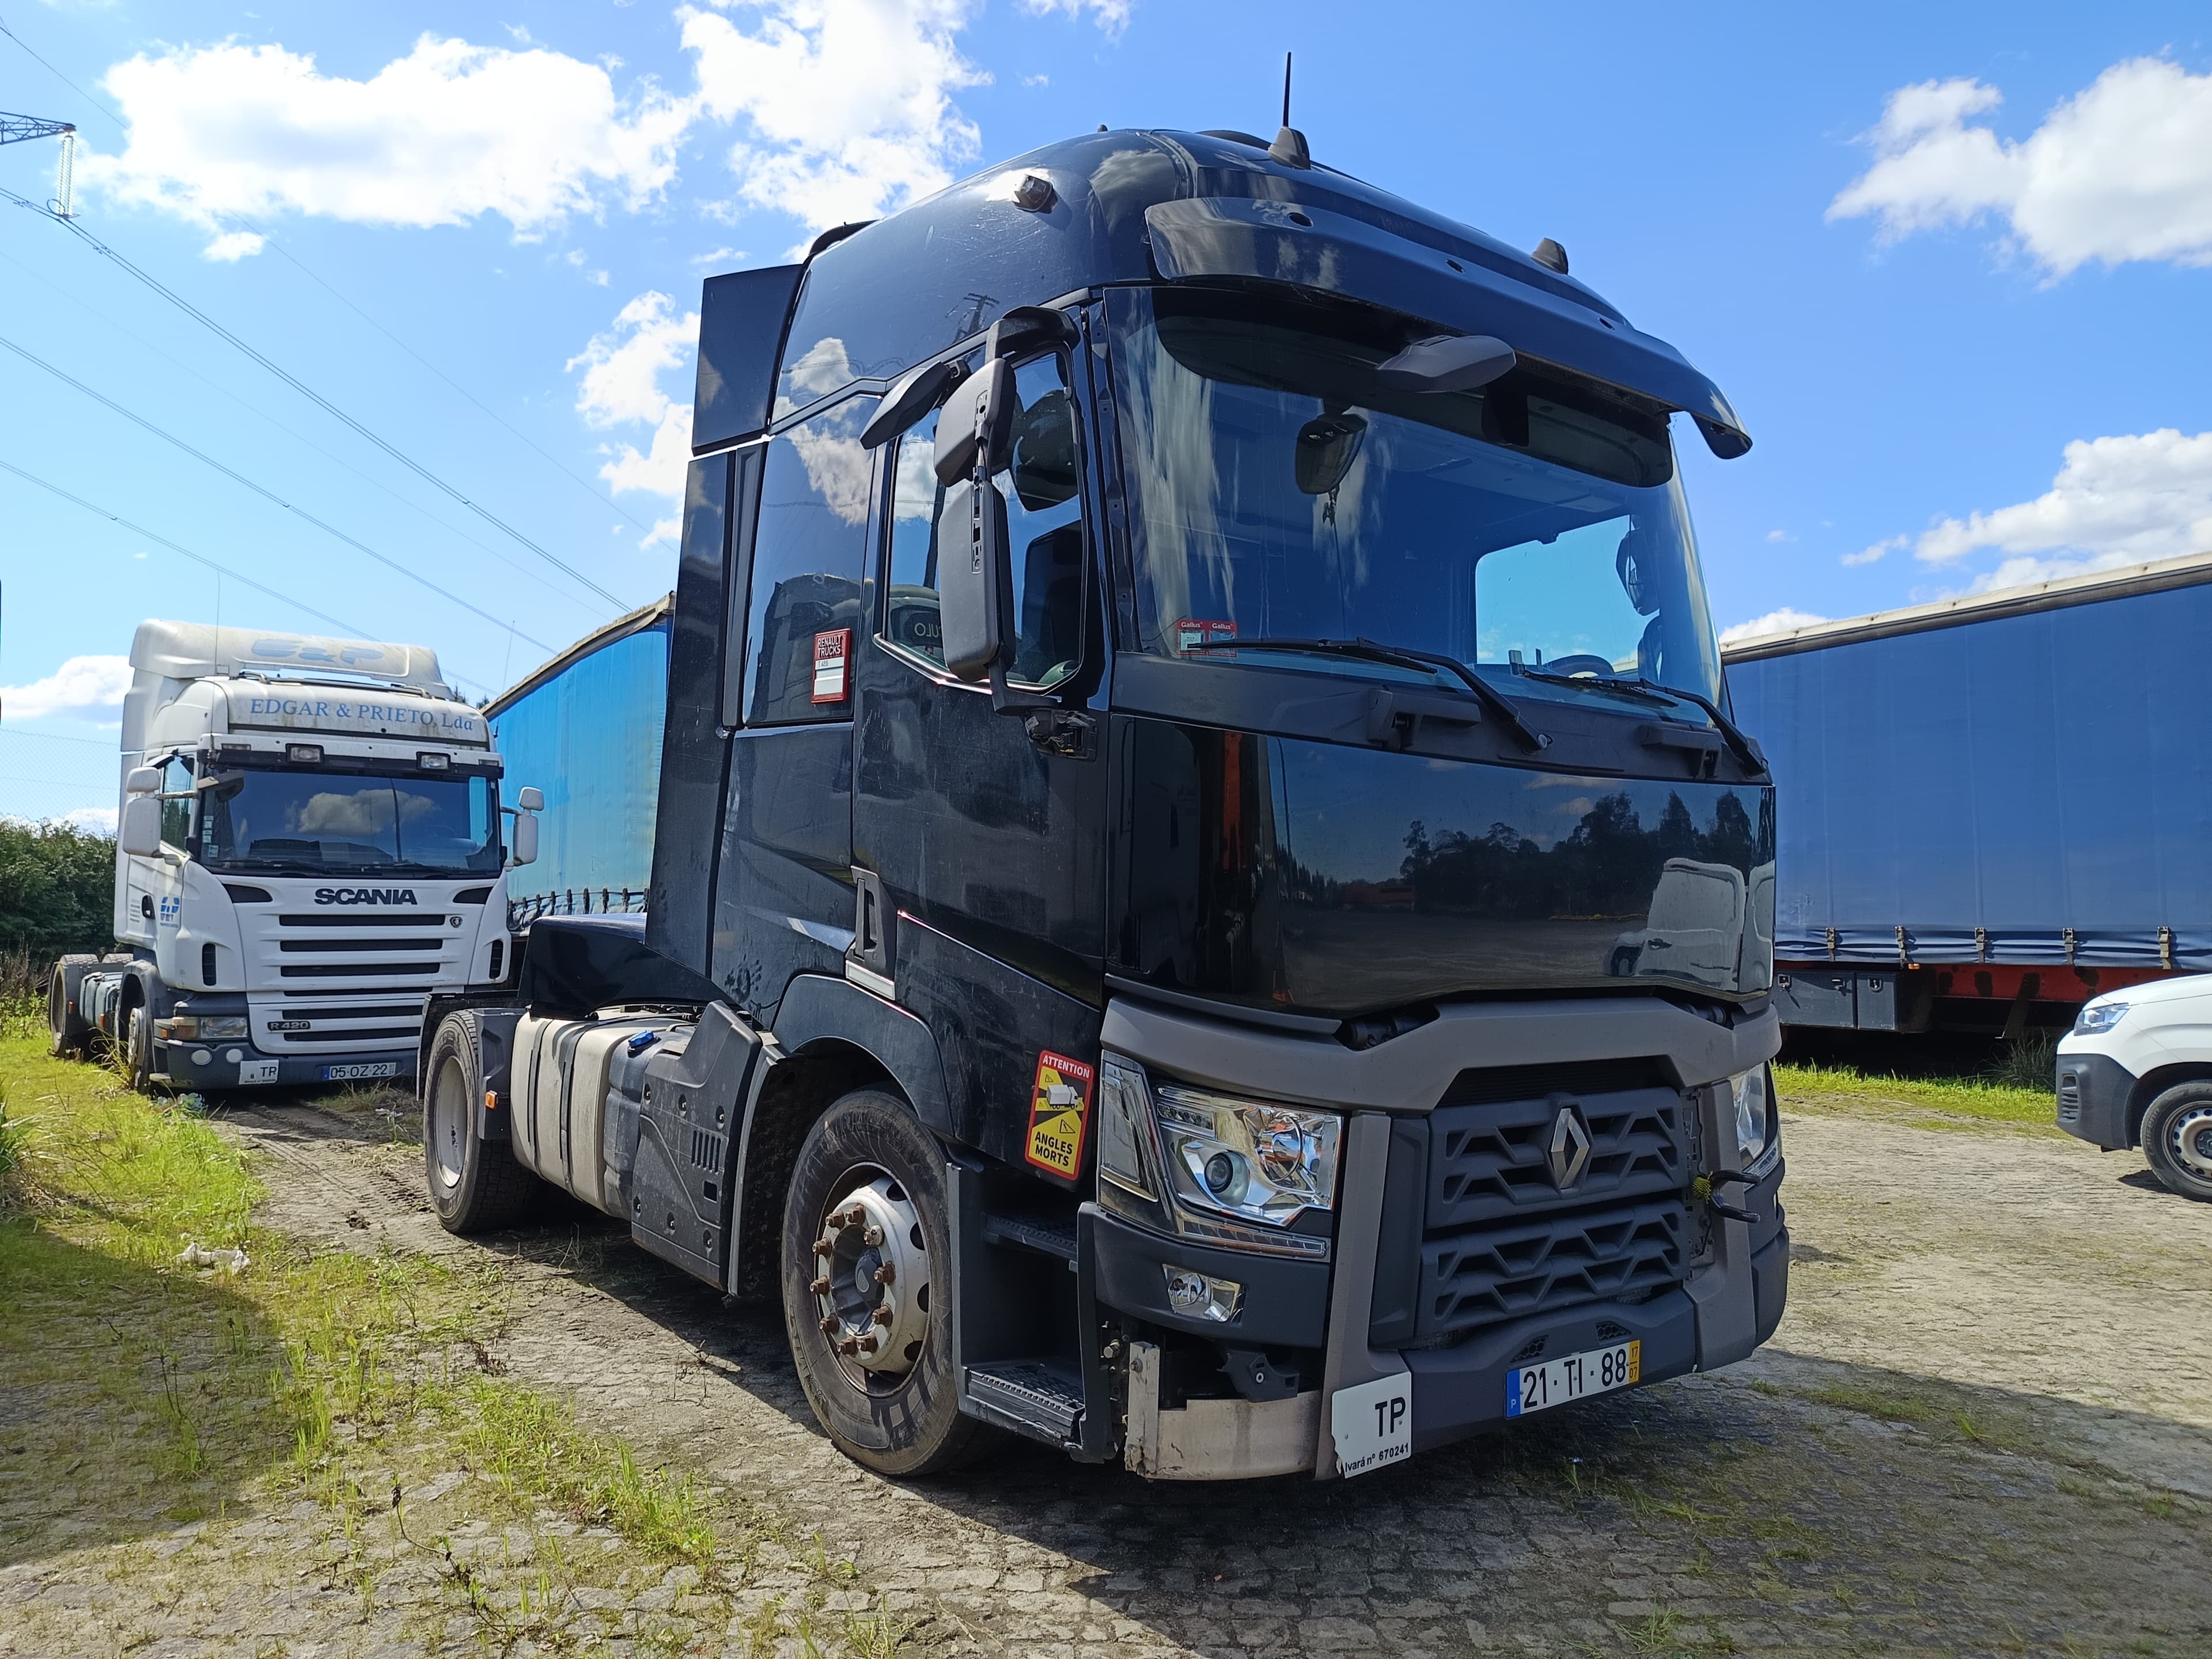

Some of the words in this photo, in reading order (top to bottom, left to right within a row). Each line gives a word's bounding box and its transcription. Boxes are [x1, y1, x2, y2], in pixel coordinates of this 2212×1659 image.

[817, 635, 841, 647] RENAULT
[817, 645, 841, 657] TRUCKS
[250, 699, 329, 716] EDGAR
[336, 703, 351, 717] &
[442, 713, 473, 730] Lda
[314, 888, 418, 905] SCANIA
[260, 1066, 276, 1077] TP
[1043, 1055, 1090, 1078] ATTENTION
[1035, 1131, 1073, 1154] ANGLES
[1035, 1144, 1069, 1166] MORTS
[1632, 1346, 1638, 1358] 17
[1630, 1366, 1637, 1378] 07
[1375, 1396, 1406, 1437] TP
[1378, 1442, 1408, 1461] 670241
